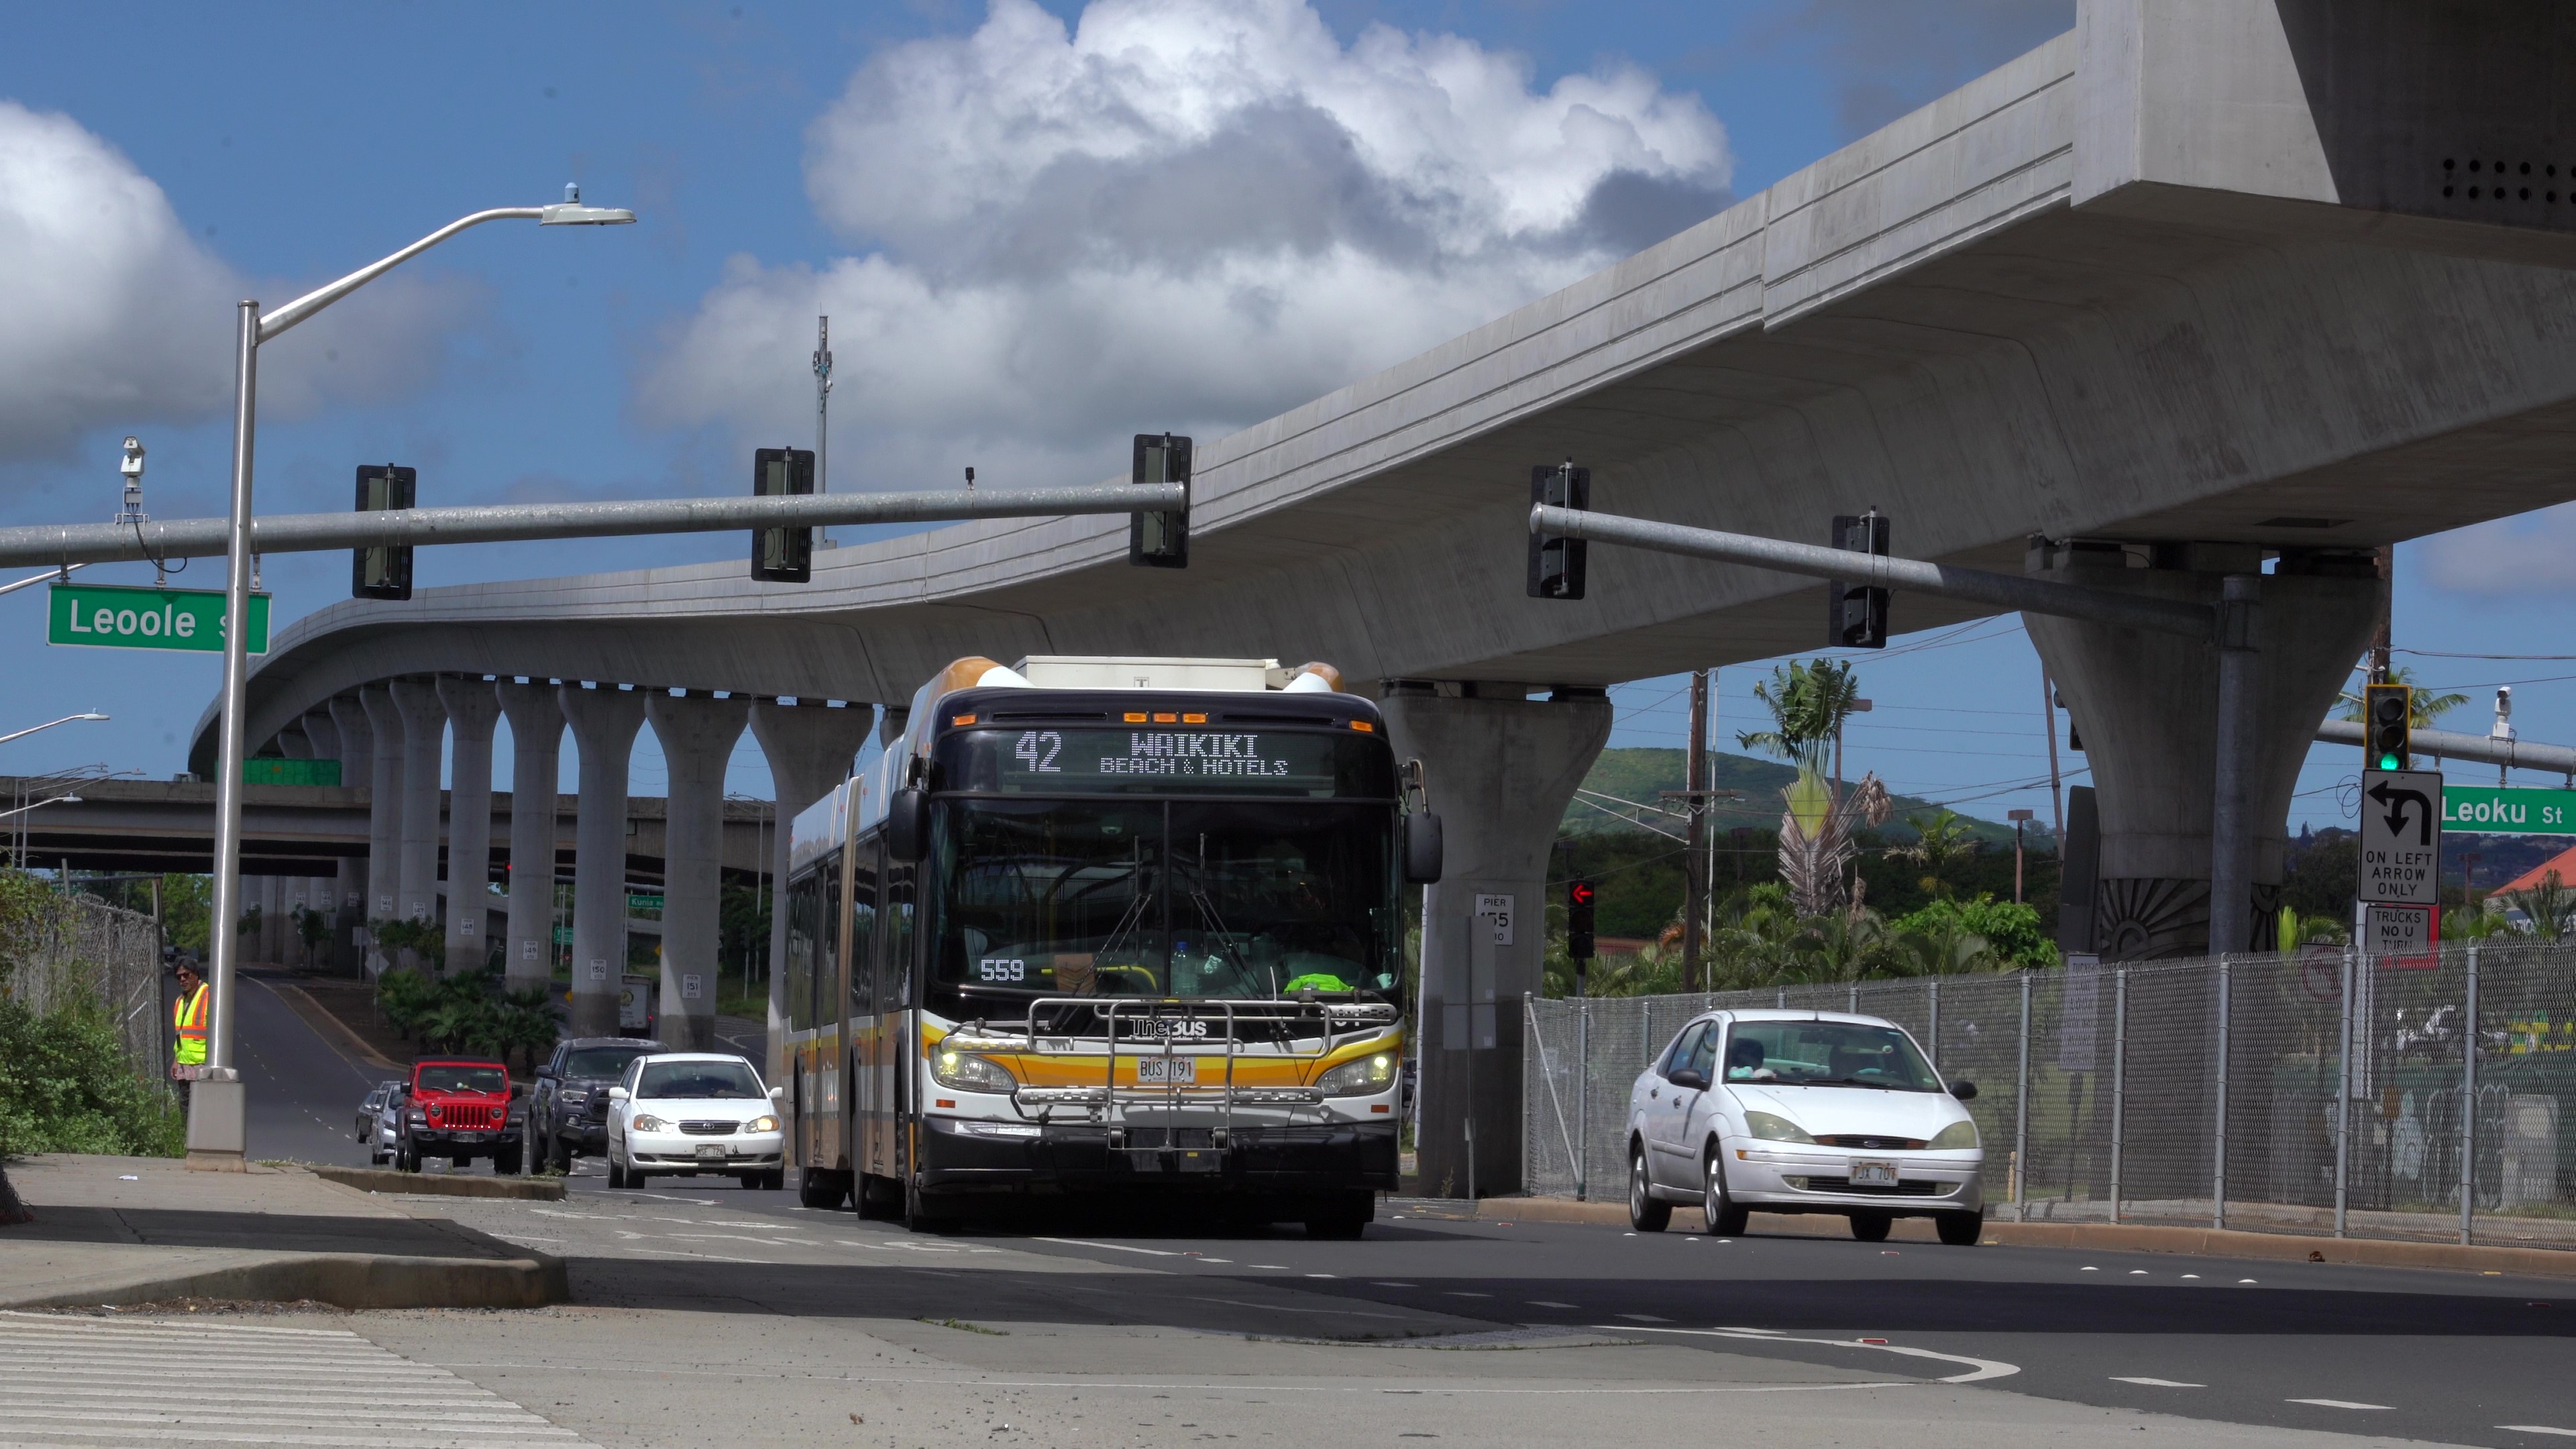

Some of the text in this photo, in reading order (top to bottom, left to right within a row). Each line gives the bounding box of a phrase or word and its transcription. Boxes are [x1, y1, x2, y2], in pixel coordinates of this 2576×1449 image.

[70, 599, 196, 637] Leoole
[1016, 731, 1061, 772] 42
[1131, 733, 1258, 757] WAIKIKI
[1100, 757, 1288, 775] BEACH & HOTELS
[2442, 796, 2563, 824] Leoku St
[2366, 851, 2432, 866] ON LEFT
[2372, 867, 2425, 881] ARROW
[2378, 882, 2417, 896] ONLY
[632, 898, 653, 906] Kunia
[1484, 898, 1506, 907] PIER
[2375, 911, 2421, 924] TRUCKS
[2381, 926, 2414, 937] NO U
[981, 959, 1024, 981] 559
[687, 982, 698, 991] 151
[1140, 1061, 1191, 1077] BUS 191
